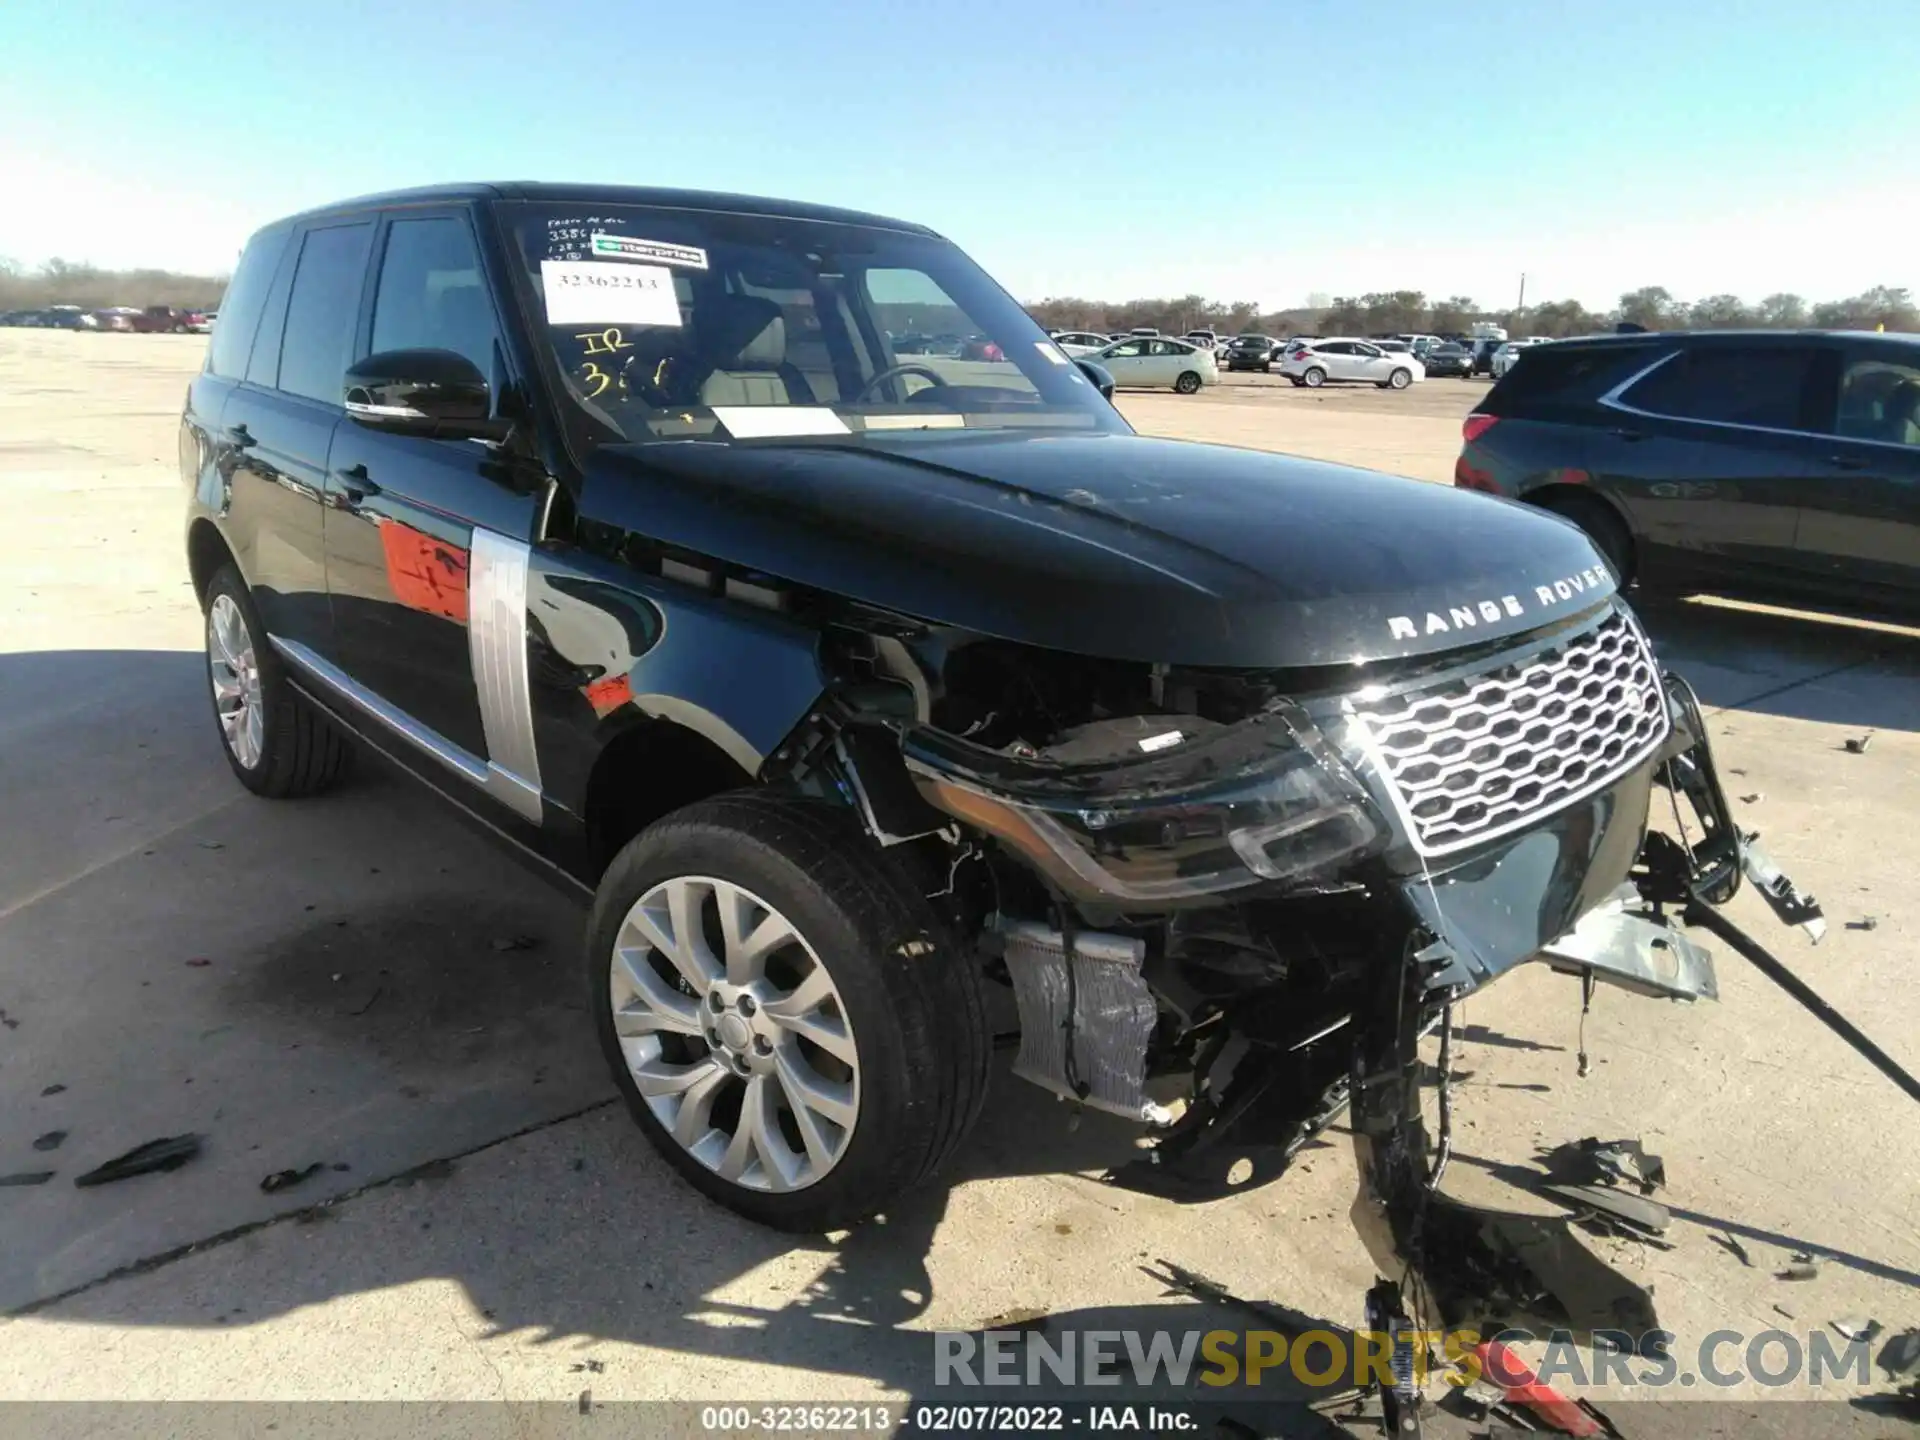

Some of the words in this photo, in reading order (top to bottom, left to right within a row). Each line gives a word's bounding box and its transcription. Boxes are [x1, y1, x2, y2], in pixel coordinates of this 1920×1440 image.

[558, 275, 658, 290] 32362213
[1387, 594, 1524, 640] RANGE
[1534, 564, 1611, 606] ROVER
